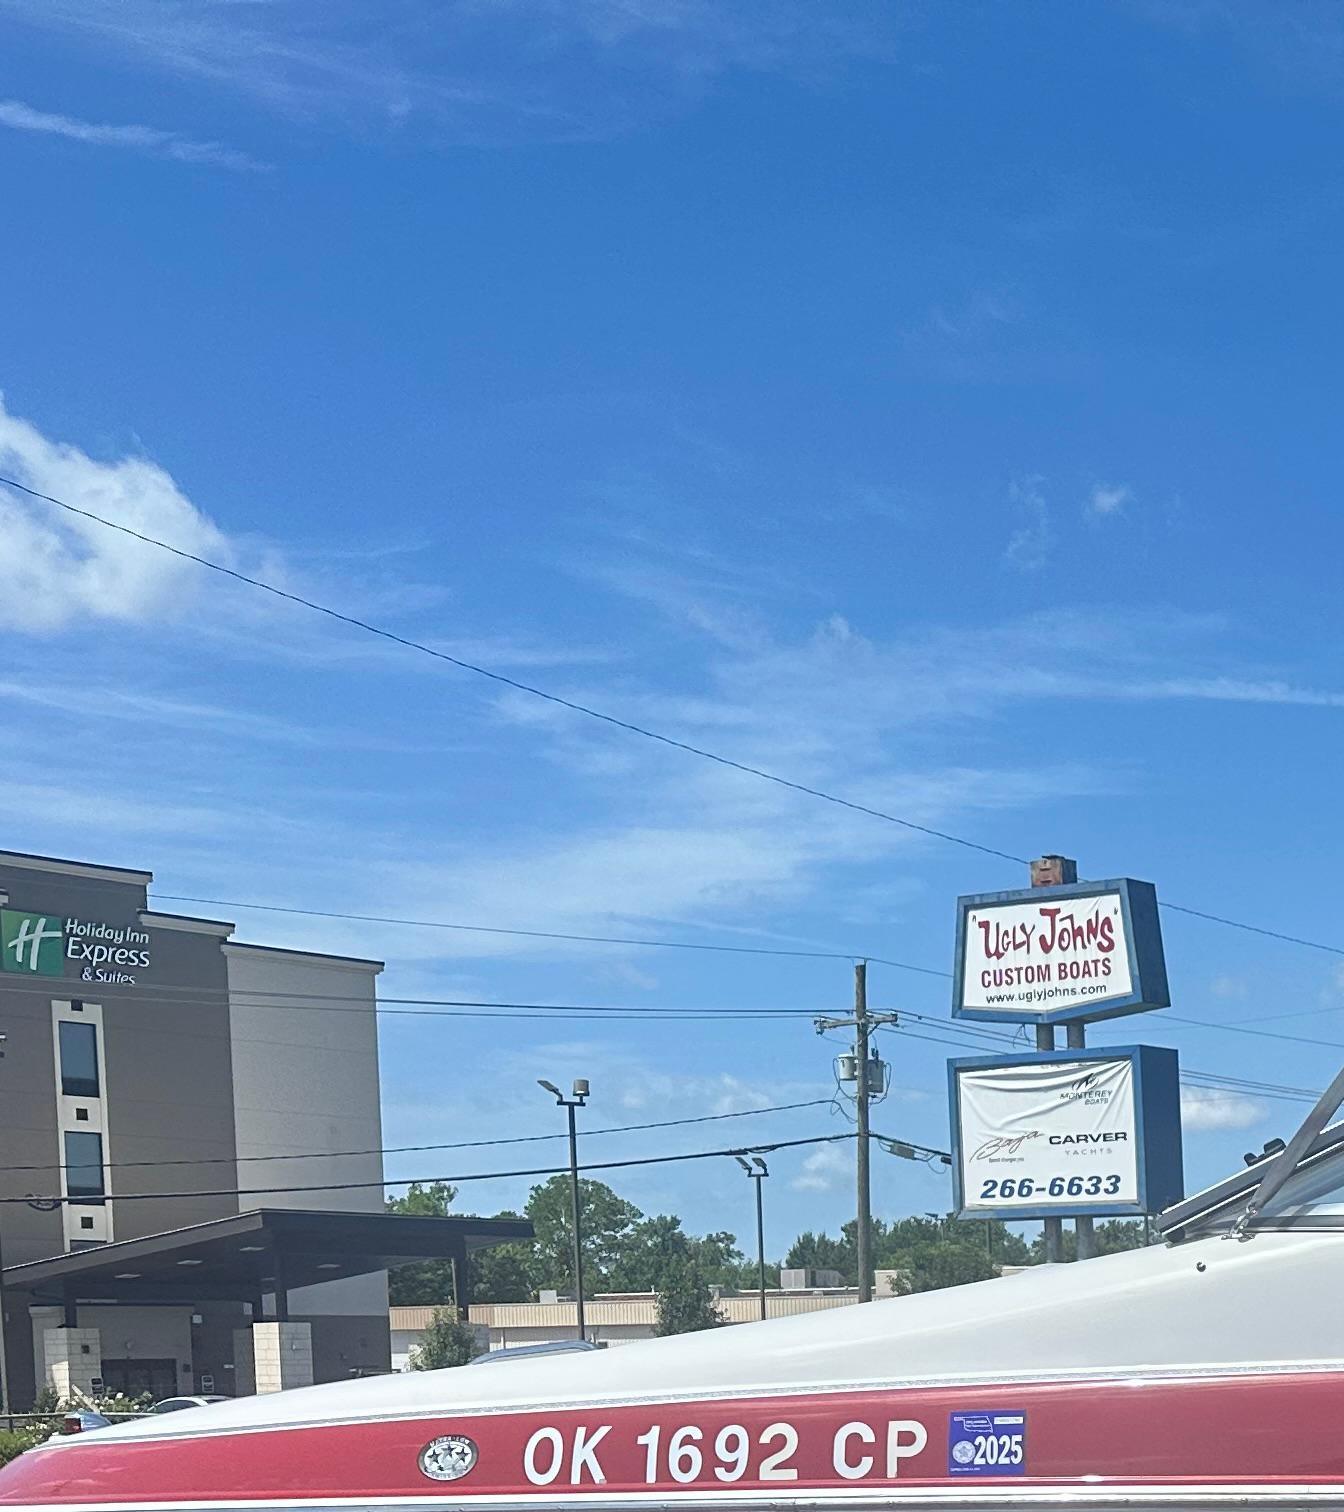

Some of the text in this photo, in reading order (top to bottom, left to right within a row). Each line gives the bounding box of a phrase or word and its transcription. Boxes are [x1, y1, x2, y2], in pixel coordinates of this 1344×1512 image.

[65, 918, 150, 944] Holiday Inn
[67, 936, 150, 967] Express
[82, 966, 136, 986] & Suites
[981, 957, 1112, 989] CUSTOM BOATS
[986, 984, 1107, 1004] www.uglyjohns.com
[1049, 1131, 1128, 1145] CARVER
[1064, 1146, 1113, 1156] YACHTS
[980, 1174, 1121, 1199] 266-6633
[524, 1420, 928, 1486] OK 1692 CP
[973, 1434, 1023, 1465] 2025
